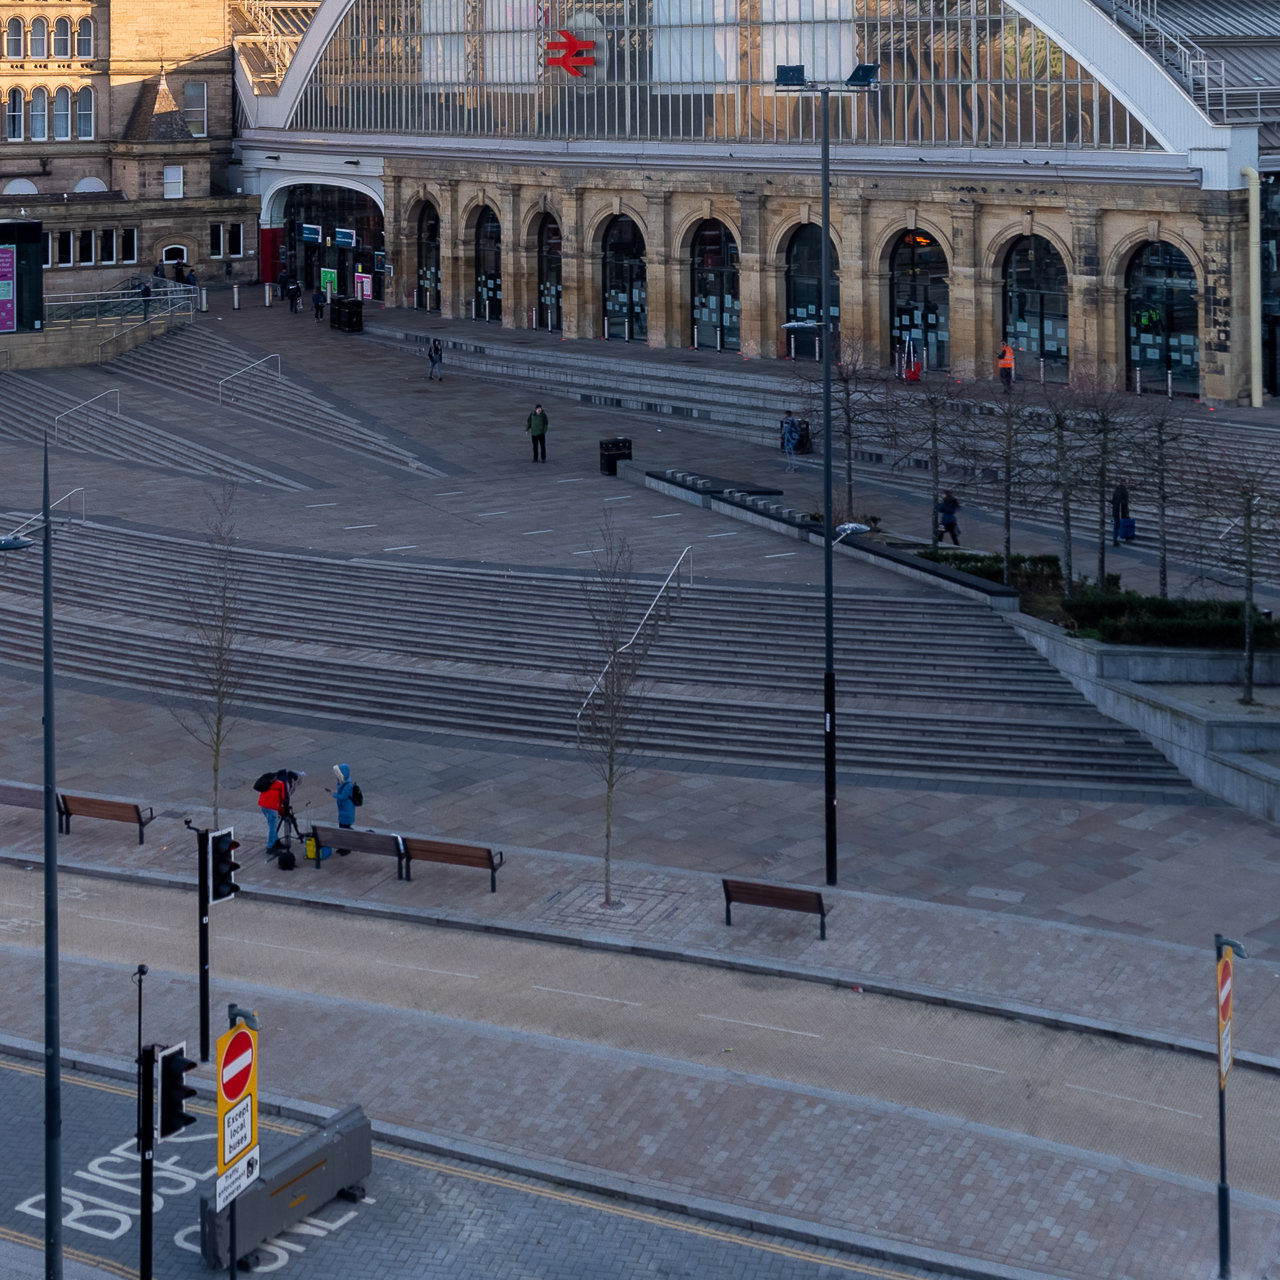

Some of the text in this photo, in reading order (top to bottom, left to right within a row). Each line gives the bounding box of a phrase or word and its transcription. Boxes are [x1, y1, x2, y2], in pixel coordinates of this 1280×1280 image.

[227, 1102, 249, 1128] Except
[230, 1118, 246, 1139] local
[229, 1134, 248, 1155] buses
